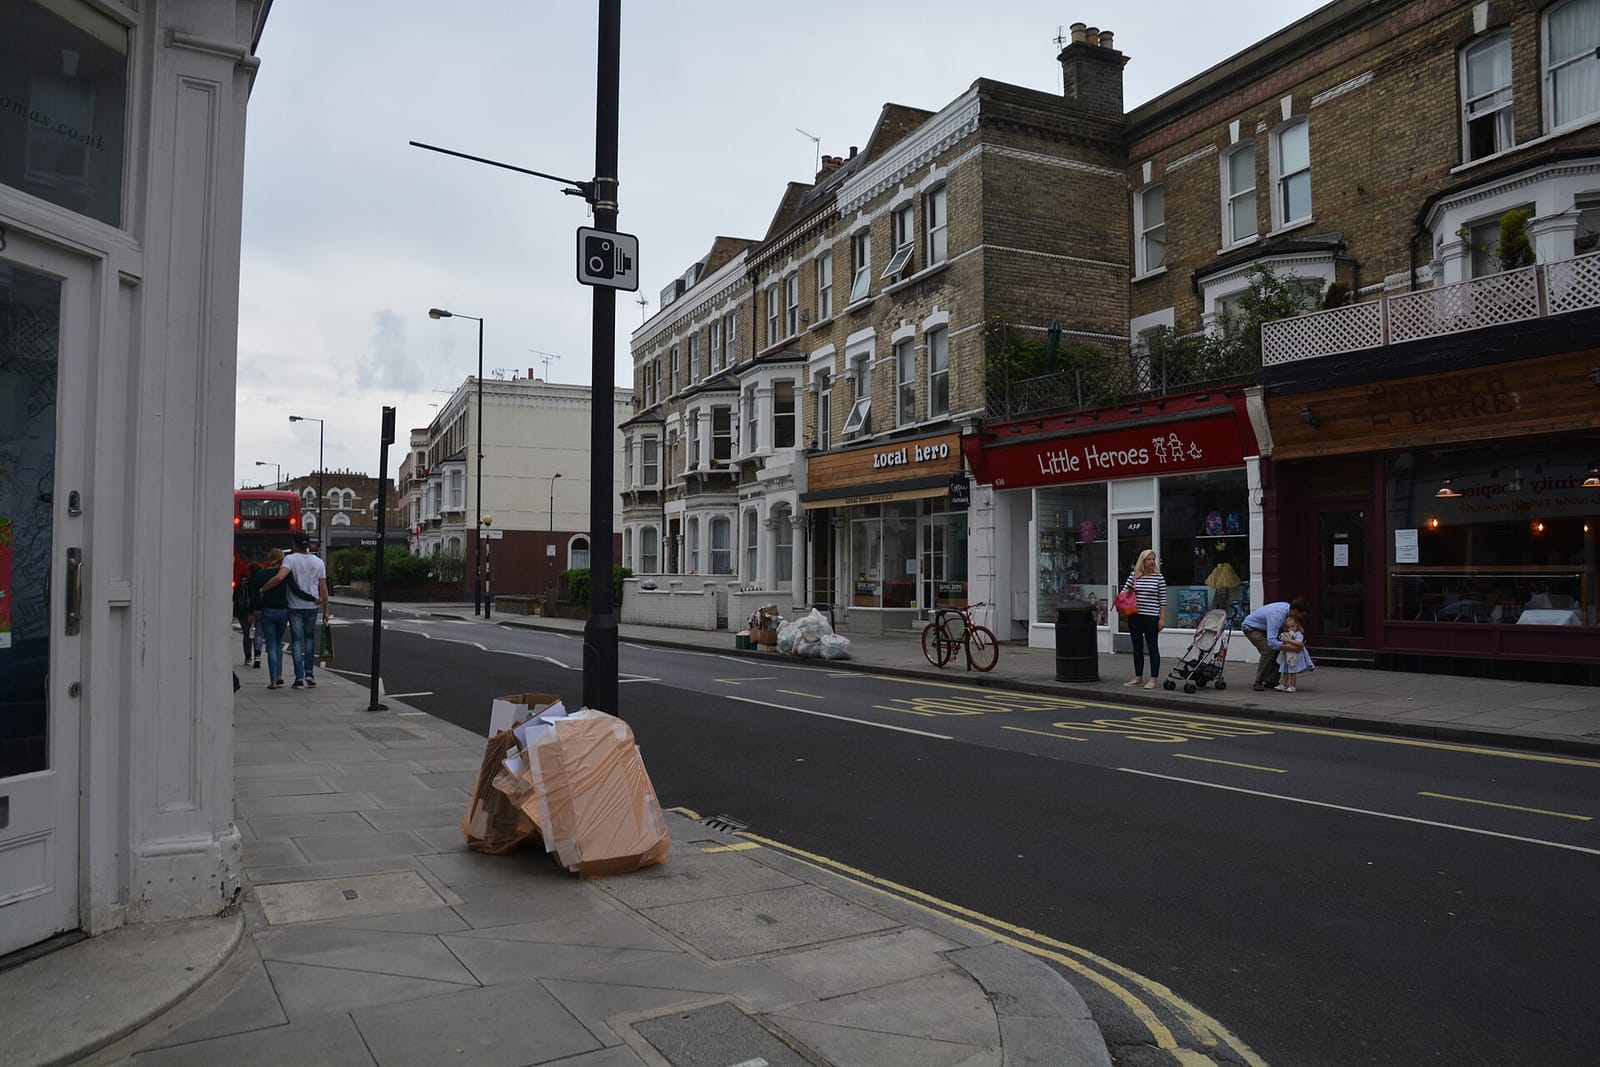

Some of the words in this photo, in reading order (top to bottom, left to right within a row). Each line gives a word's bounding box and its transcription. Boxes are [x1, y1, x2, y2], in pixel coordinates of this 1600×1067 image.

[873, 447, 908, 469] Local
[915, 443, 949, 462] hero
[1038, 448, 1081, 475] Little
[1084, 444, 1149, 470] Heroes
